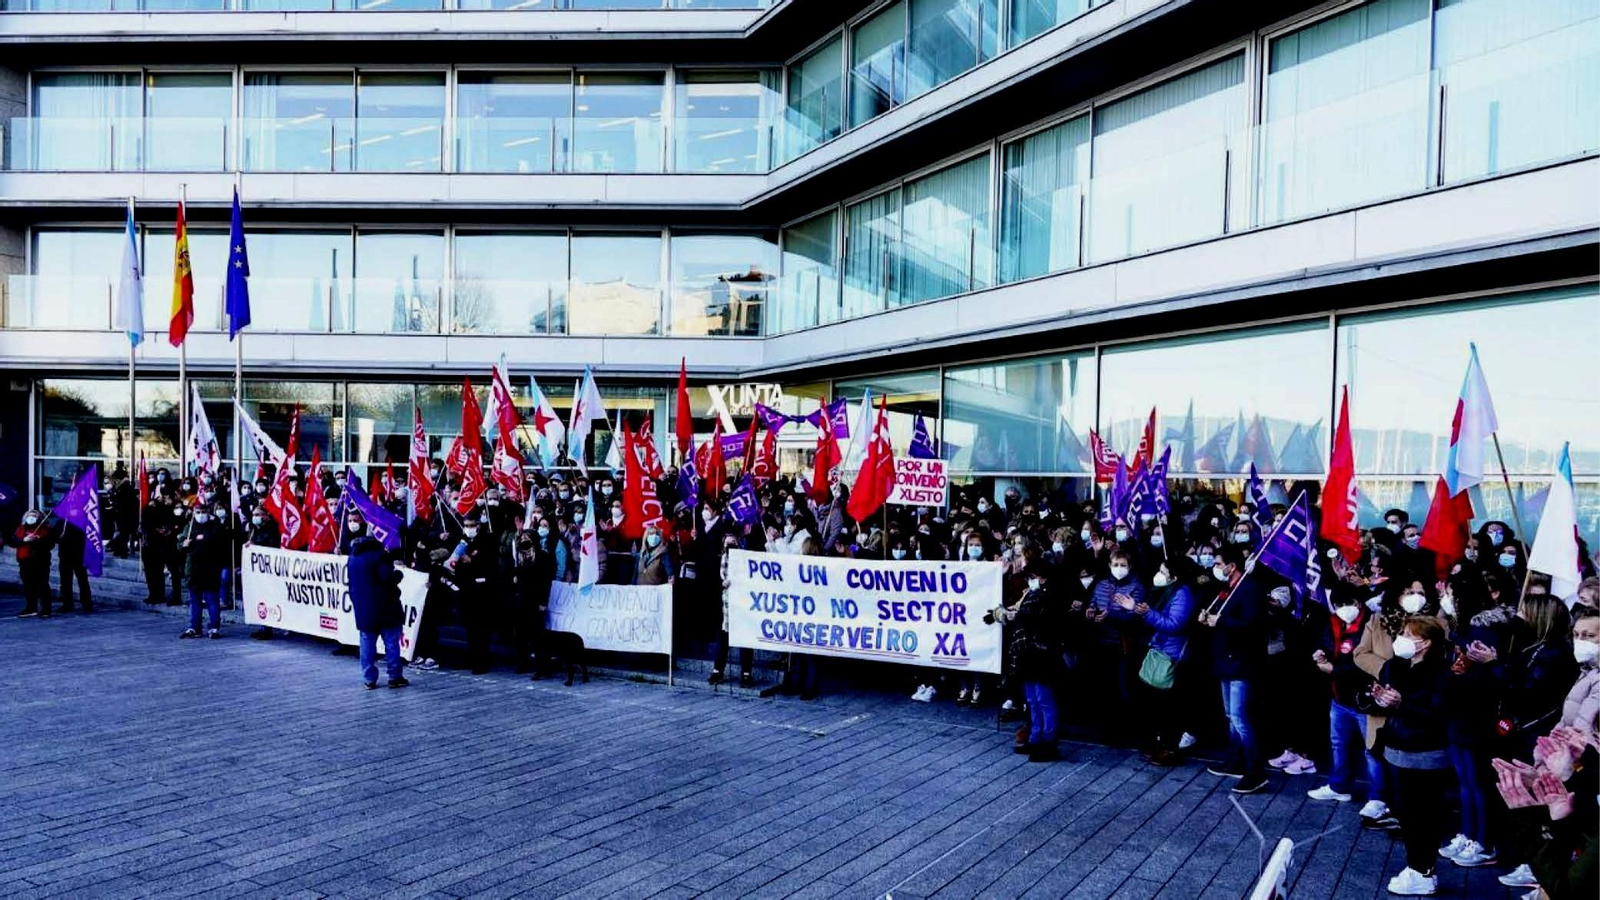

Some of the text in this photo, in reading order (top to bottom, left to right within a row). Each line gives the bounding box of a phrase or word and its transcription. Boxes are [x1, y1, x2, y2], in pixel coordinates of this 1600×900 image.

[706, 384, 784, 434] XUNTA
[897, 459, 943, 474] POR UN
[900, 488, 943, 503] XUSTO
[251, 552, 273, 574] POR
[275, 554, 290, 577] UN
[749, 559, 783, 582] POR
[799, 563, 828, 586] UN
[285, 581, 325, 607] XUSTO
[749, 591, 967, 625] XUSTO NO SECTOR
[933, 632, 968, 656] XA
